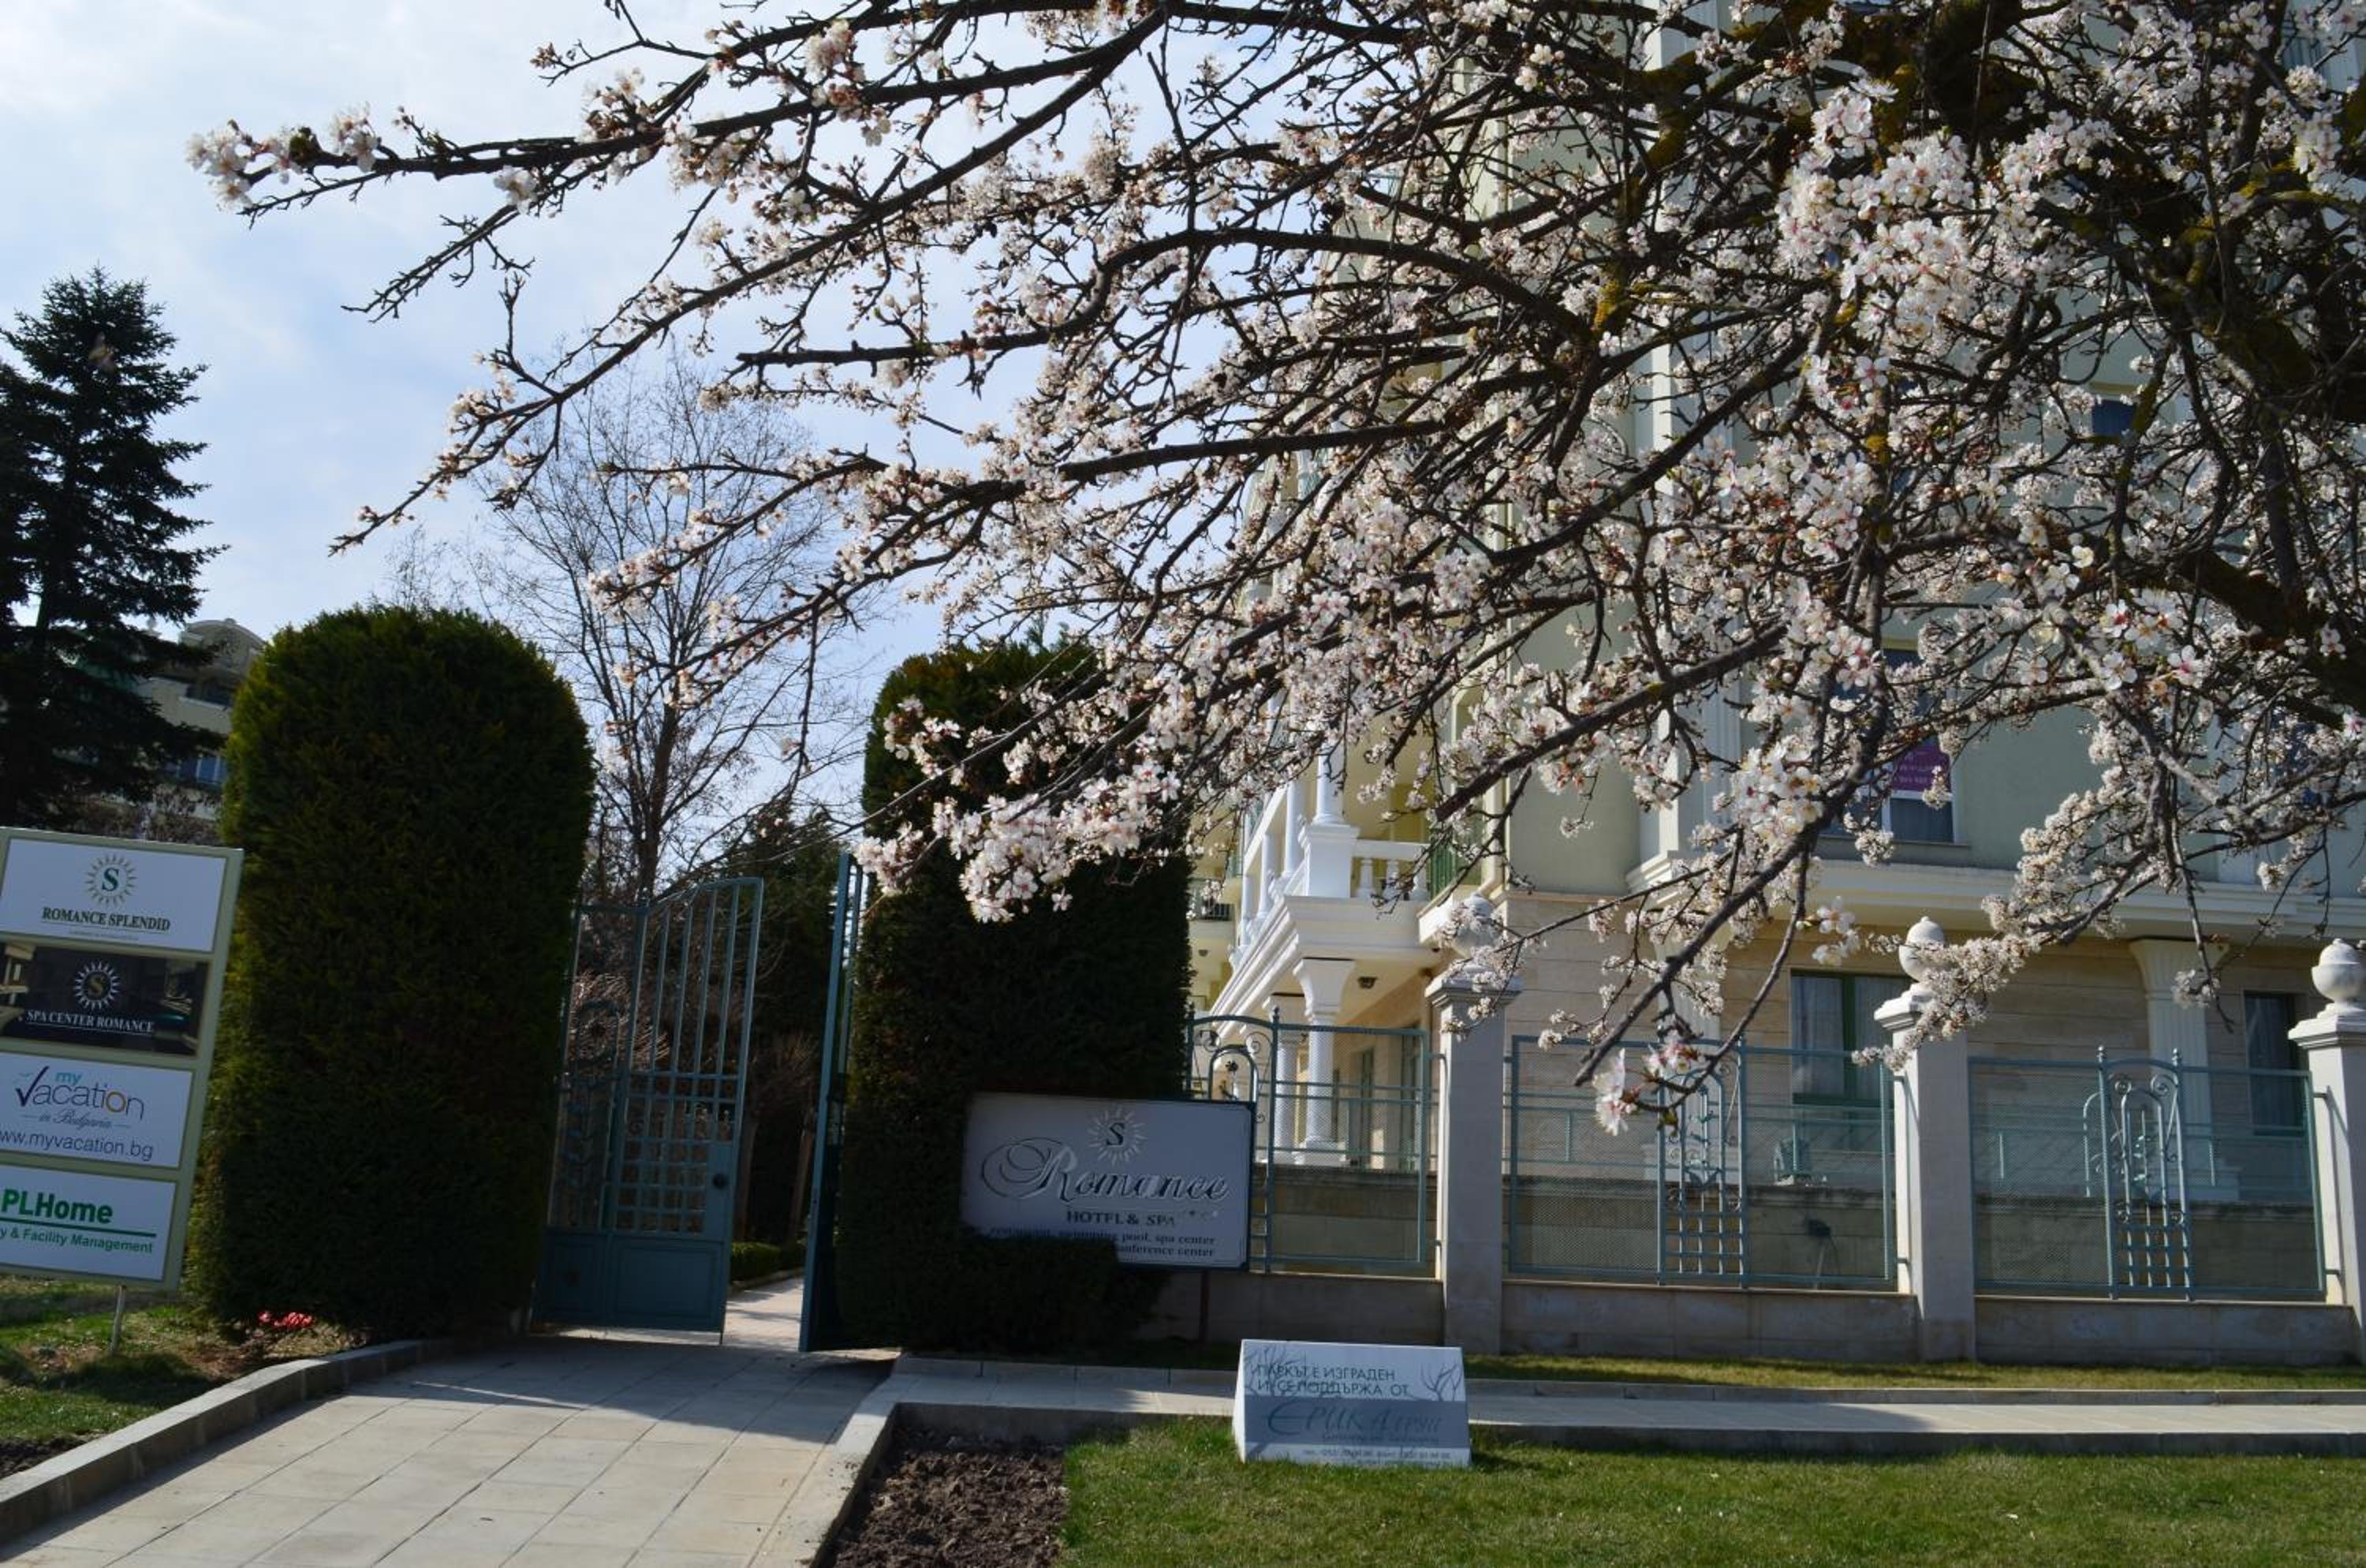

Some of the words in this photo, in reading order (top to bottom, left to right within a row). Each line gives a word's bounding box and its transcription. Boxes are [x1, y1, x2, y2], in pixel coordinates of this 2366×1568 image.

[42, 906, 106, 926] ROMANCE
[26, 1009, 47, 1023] SPA
[49, 1010, 95, 1027] CENTER
[96, 1015, 155, 1033] ROMANCE
[56, 1072, 82, 1086] my
[981, 1137, 1228, 1203] Romance
[2, 1188, 114, 1224] PLHome
[1065, 1211, 1123, 1225] HOTEL
[1125, 1211, 1140, 1225] &
[1146, 1213, 1175, 1226] SPA
[10, 1227, 19, 1239] &
[23, 1228, 68, 1247] Facility
[71, 1234, 154, 1254] Management
[1178, 1236, 1215, 1245] center
[1177, 1248, 1213, 1257] center
[1324, 1366, 1395, 1381] ИЗГРАДЕН
[1277, 1380, 1297, 1393] СЕ
[1298, 1380, 1383, 1395] ПОДДЪРЖА
[1390, 1383, 1410, 1396] ОТ
